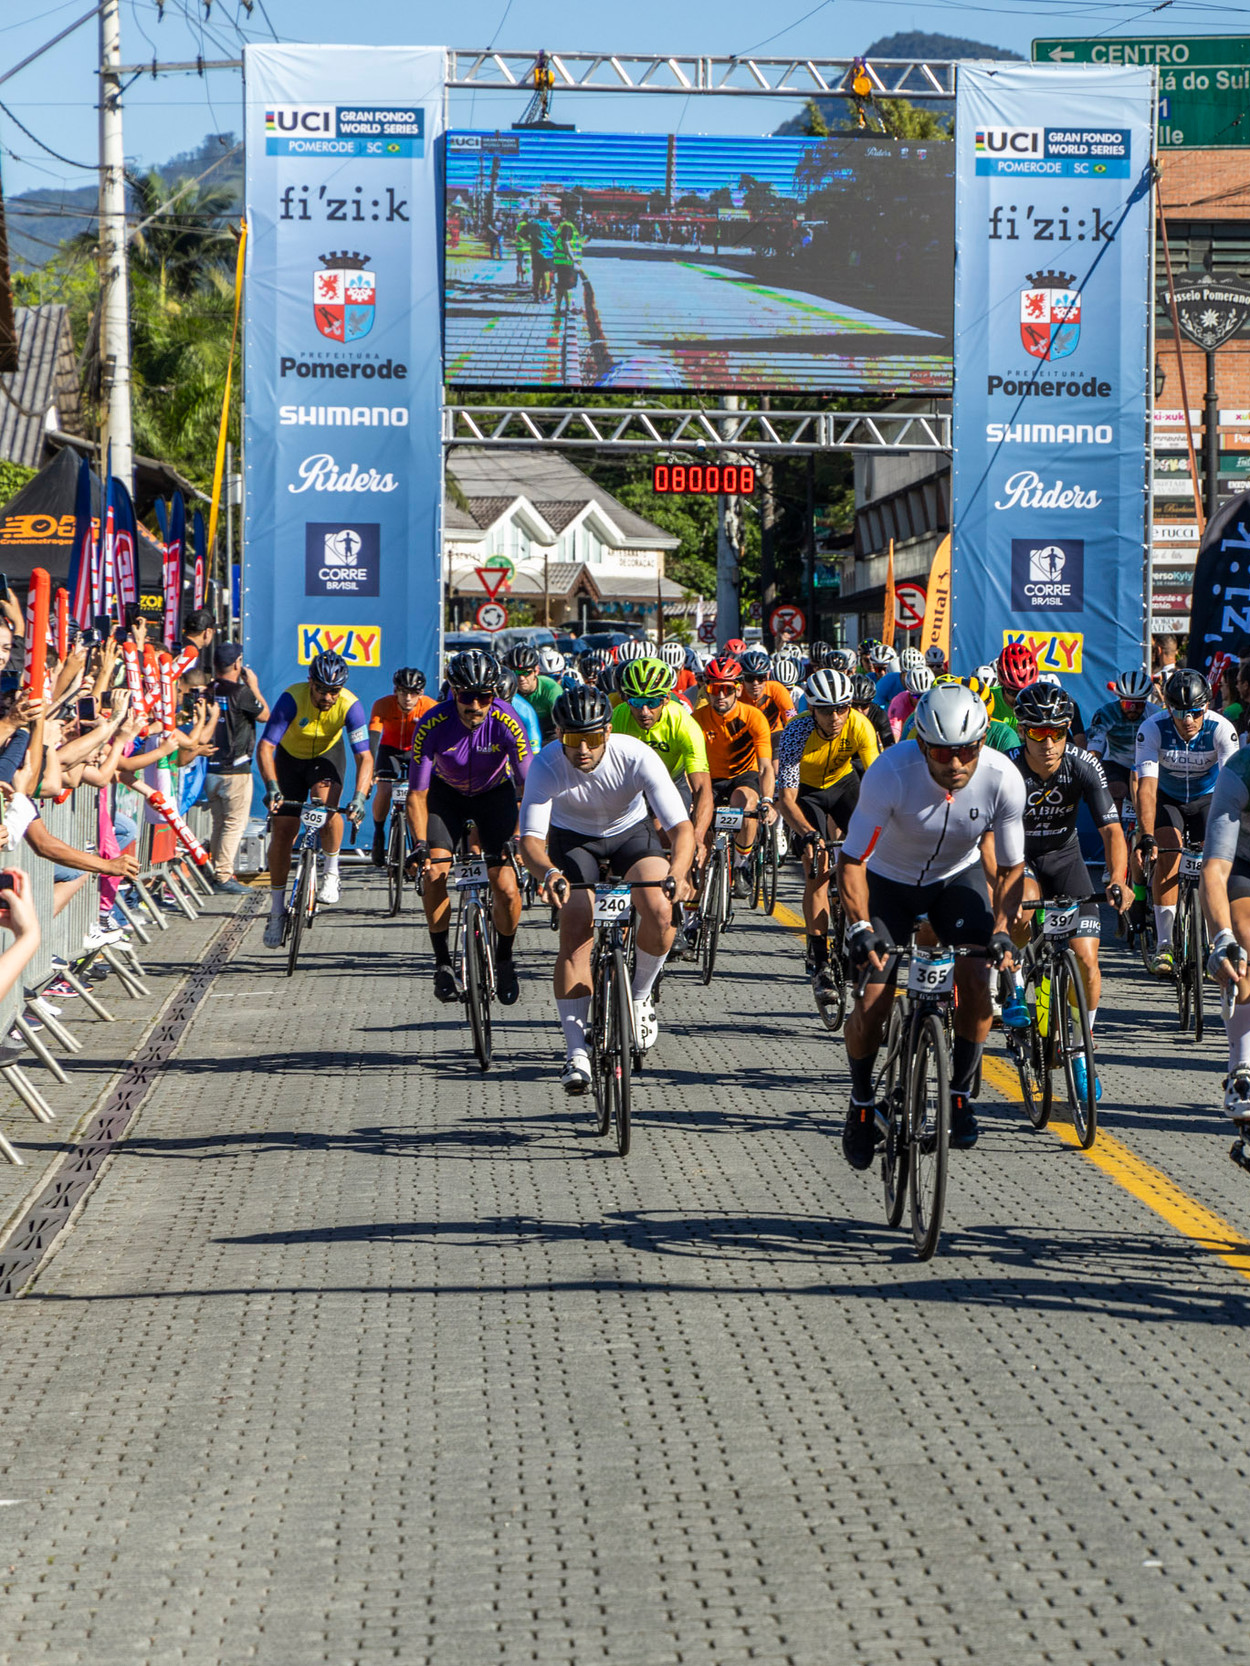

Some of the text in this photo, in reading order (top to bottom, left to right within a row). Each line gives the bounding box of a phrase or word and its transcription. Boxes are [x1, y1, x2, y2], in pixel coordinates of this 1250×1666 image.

[1091, 44, 1189, 63] CENTRO
[1183, 72, 1209, 90] do
[1216, 70, 1250, 90] Sul
[278, 111, 329, 132] UCI
[340, 111, 415, 122] GRAN FONDO
[340, 123, 418, 134] WORLD SERIES
[987, 132, 1038, 152] UCI
[1048, 132, 1122, 143] GRAN FONDO
[289, 140, 382, 153] POMERODE SC
[1048, 144, 1125, 155] WORLD SERIES
[998, 161, 1089, 173] POMERODE SC
[1203, 289, 1250, 305] Pomerano
[280, 357, 407, 379] Pomerode
[987, 375, 1112, 398] Pomerode
[279, 406, 409, 427] SHIMANO
[1154, 412, 1184, 420] ki-xuk
[986, 424, 1113, 444] SHIMANO
[288, 454, 399, 493] Riders
[655, 465, 755, 494] 080008
[995, 470, 1102, 510] Riders
[318, 568, 367, 581] CORRE
[326, 581, 359, 590] BRASIL
[1024, 584, 1071, 596] CORRE
[1031, 596, 1063, 606] BRASIL
[929, 588, 949, 648] ental
[303, 627, 376, 662] KYLY
[413, 713, 449, 764] ARRIVAL
[491, 709, 528, 762] ARRIVAL
[1064, 744, 1079, 756] LA
[304, 812, 322, 823] 305
[720, 816, 738, 825] 227
[461, 866, 482, 878] 214
[599, 898, 626, 912] 240
[1050, 914, 1074, 927] 397
[917, 968, 947, 984] 365
